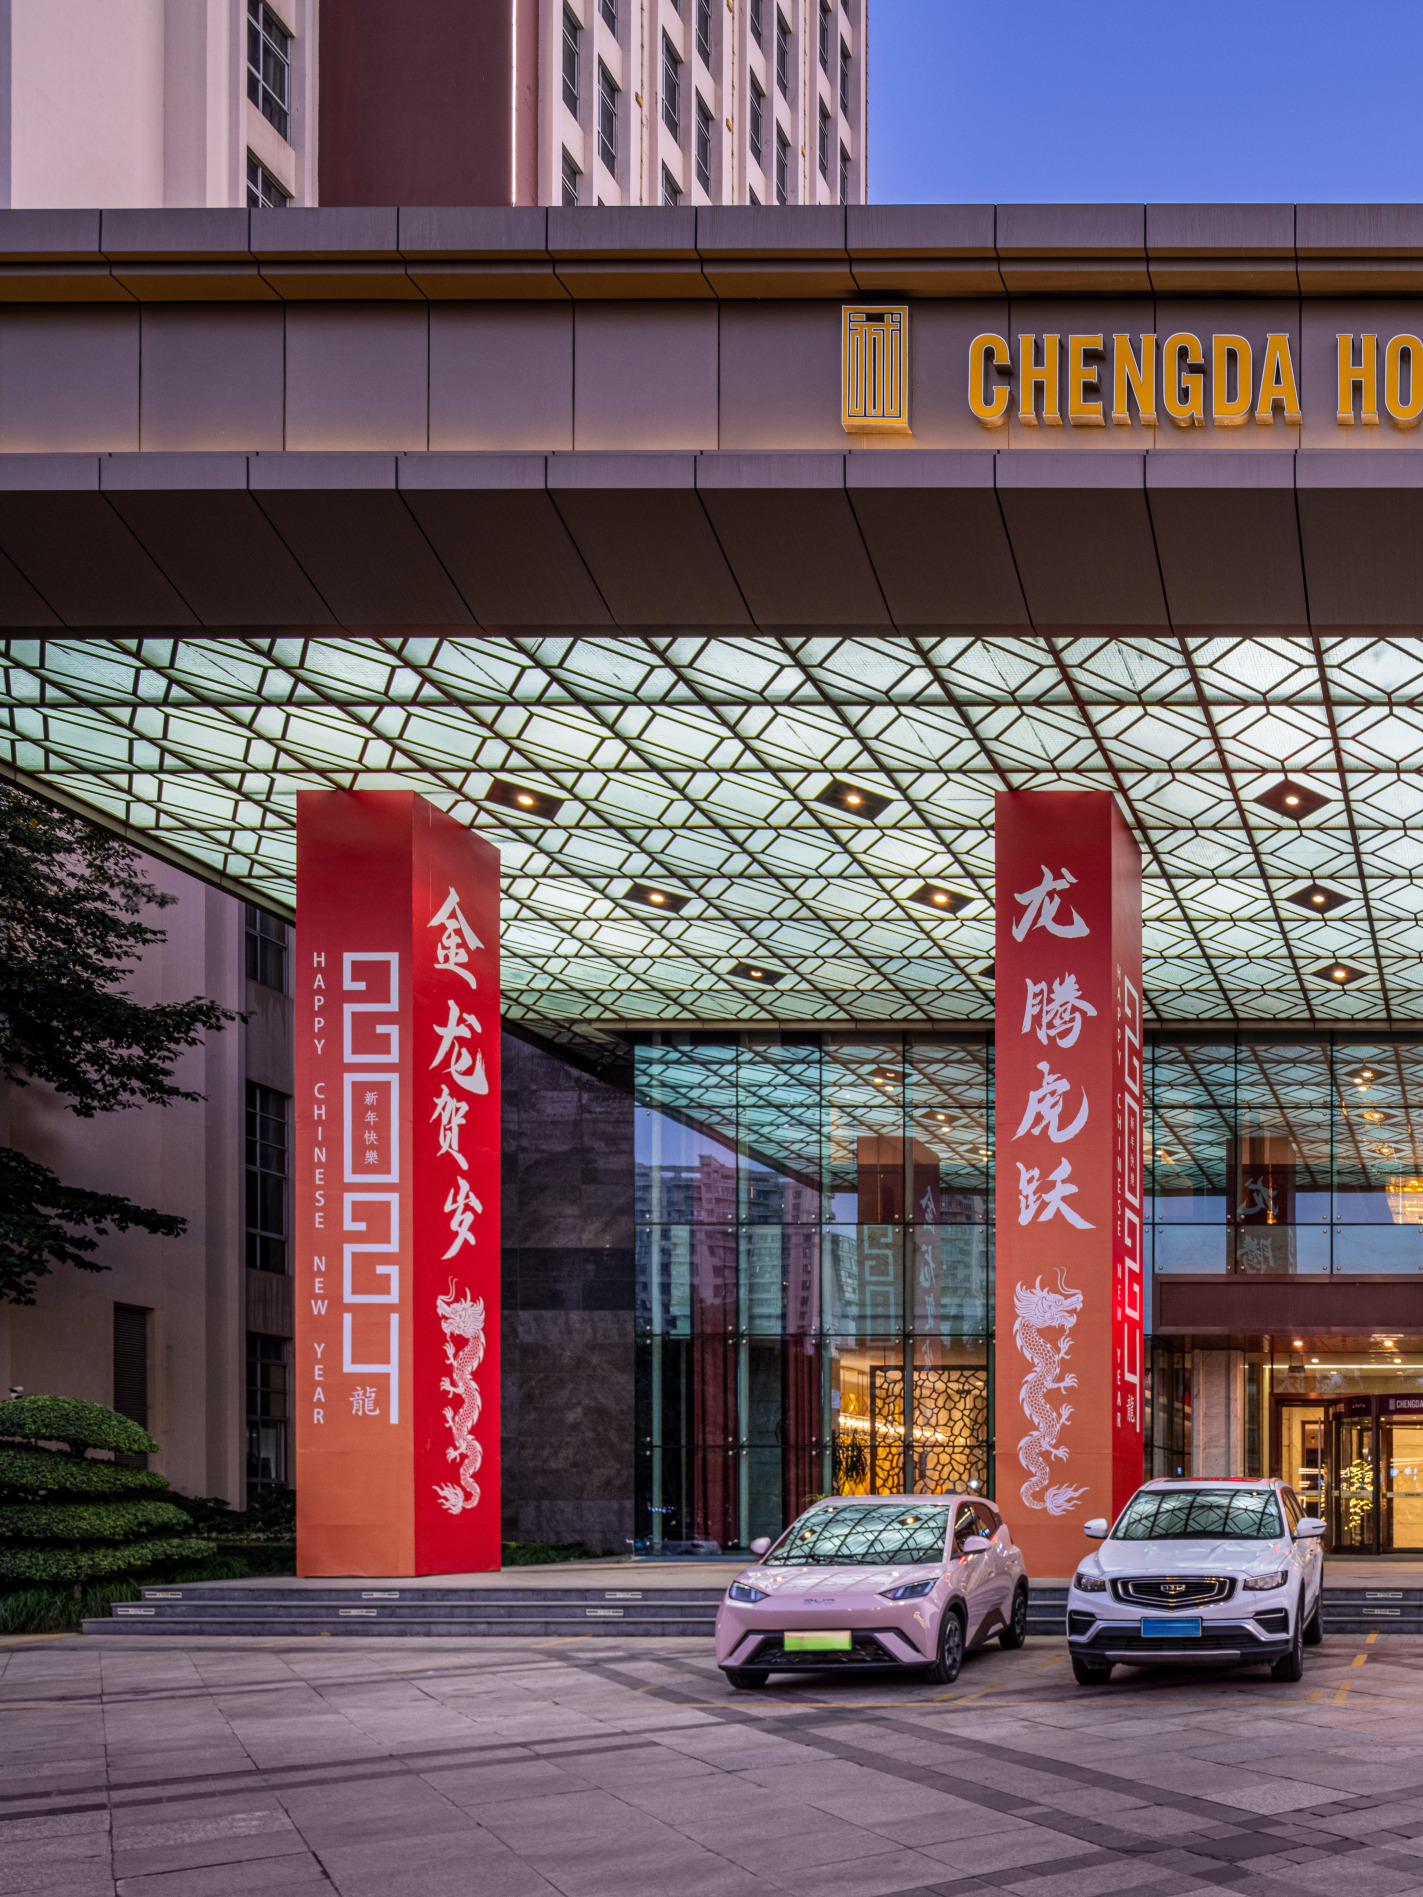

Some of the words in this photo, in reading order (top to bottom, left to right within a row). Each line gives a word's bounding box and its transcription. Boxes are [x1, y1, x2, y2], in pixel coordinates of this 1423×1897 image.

[968, 332, 1303, 428] CHENGDA
[313, 952, 326, 1055] HAPPY
[1010, 864, 1098, 1231] 龙腾虎跃
[427, 886, 490, 1261] 金龙贺岁
[313, 1082, 327, 1228] CHINESE
[363, 1090, 380, 1166] 新年快樂
[311, 1256, 329, 1316] NEW
[312, 1343, 326, 1425] YEAR
[348, 1385, 382, 1417] 龍
[1396, 1399, 1423, 1409] CHENGDA
